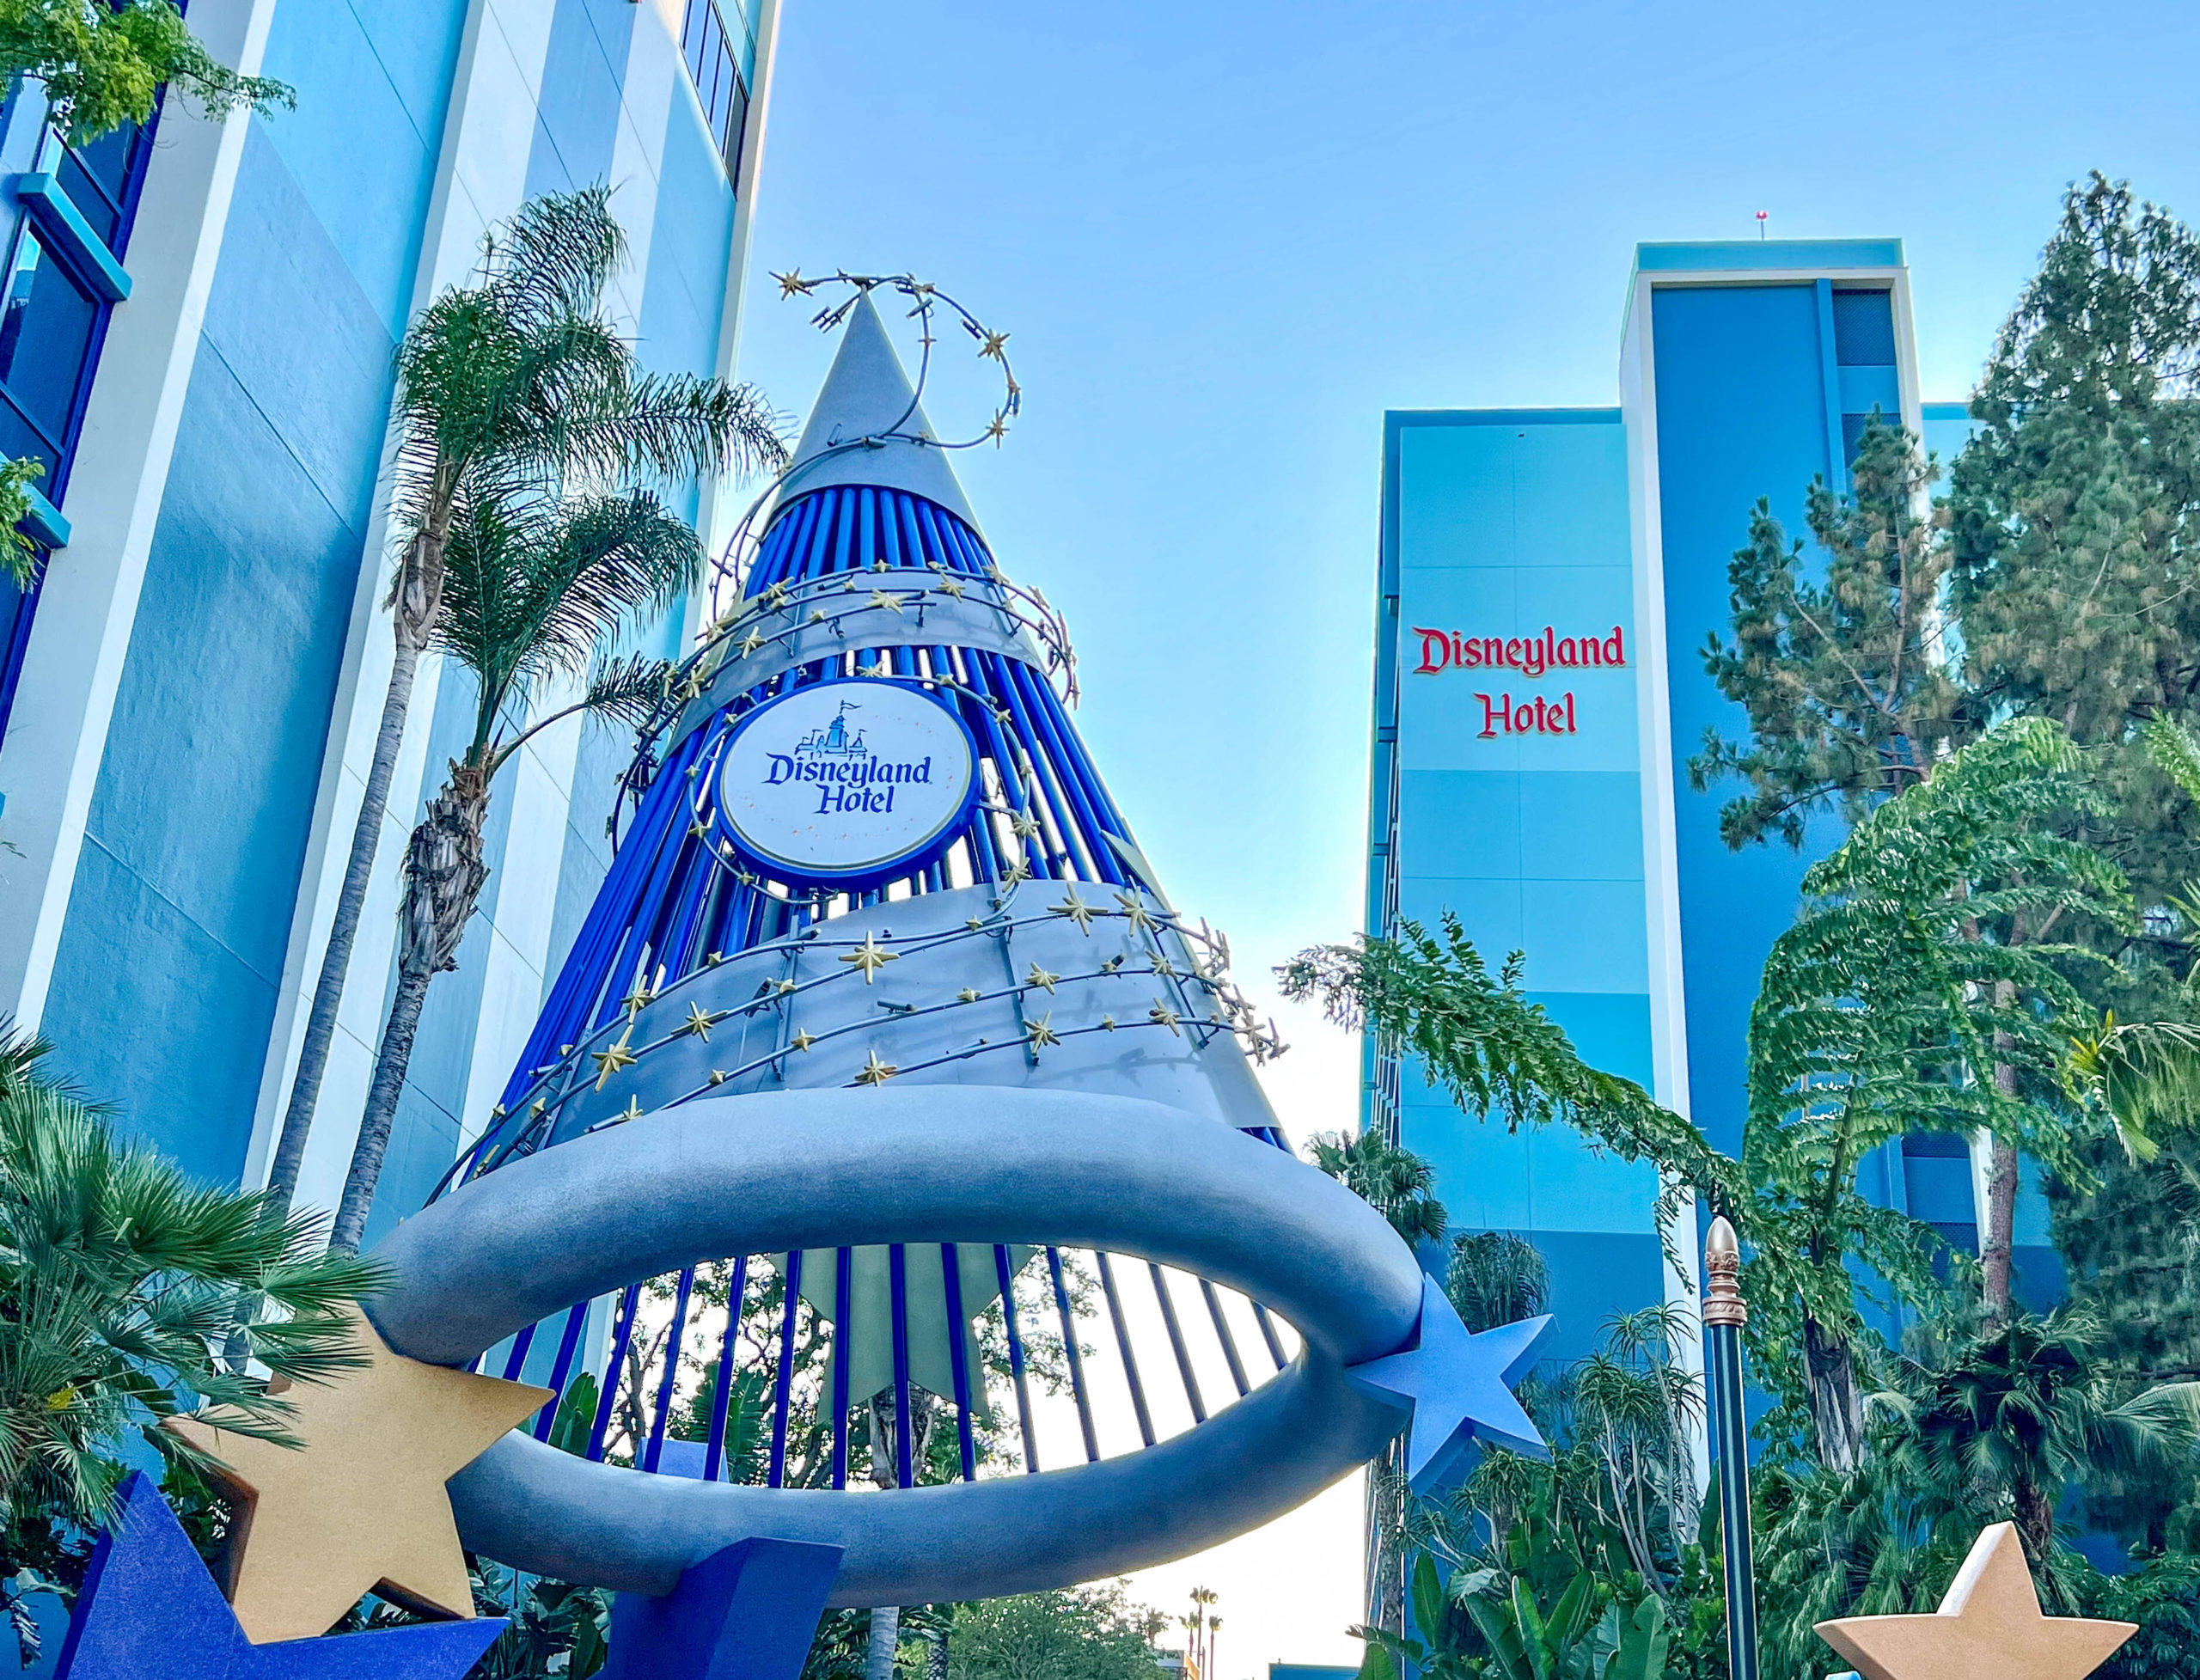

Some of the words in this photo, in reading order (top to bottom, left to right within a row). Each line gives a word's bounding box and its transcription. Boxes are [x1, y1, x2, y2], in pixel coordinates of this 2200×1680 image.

[1412, 626, 1626, 676] Disneyland
[1472, 692, 1578, 738] Hotel
[762, 753, 932, 788] Disneyland
[812, 783, 895, 814] Hotel
